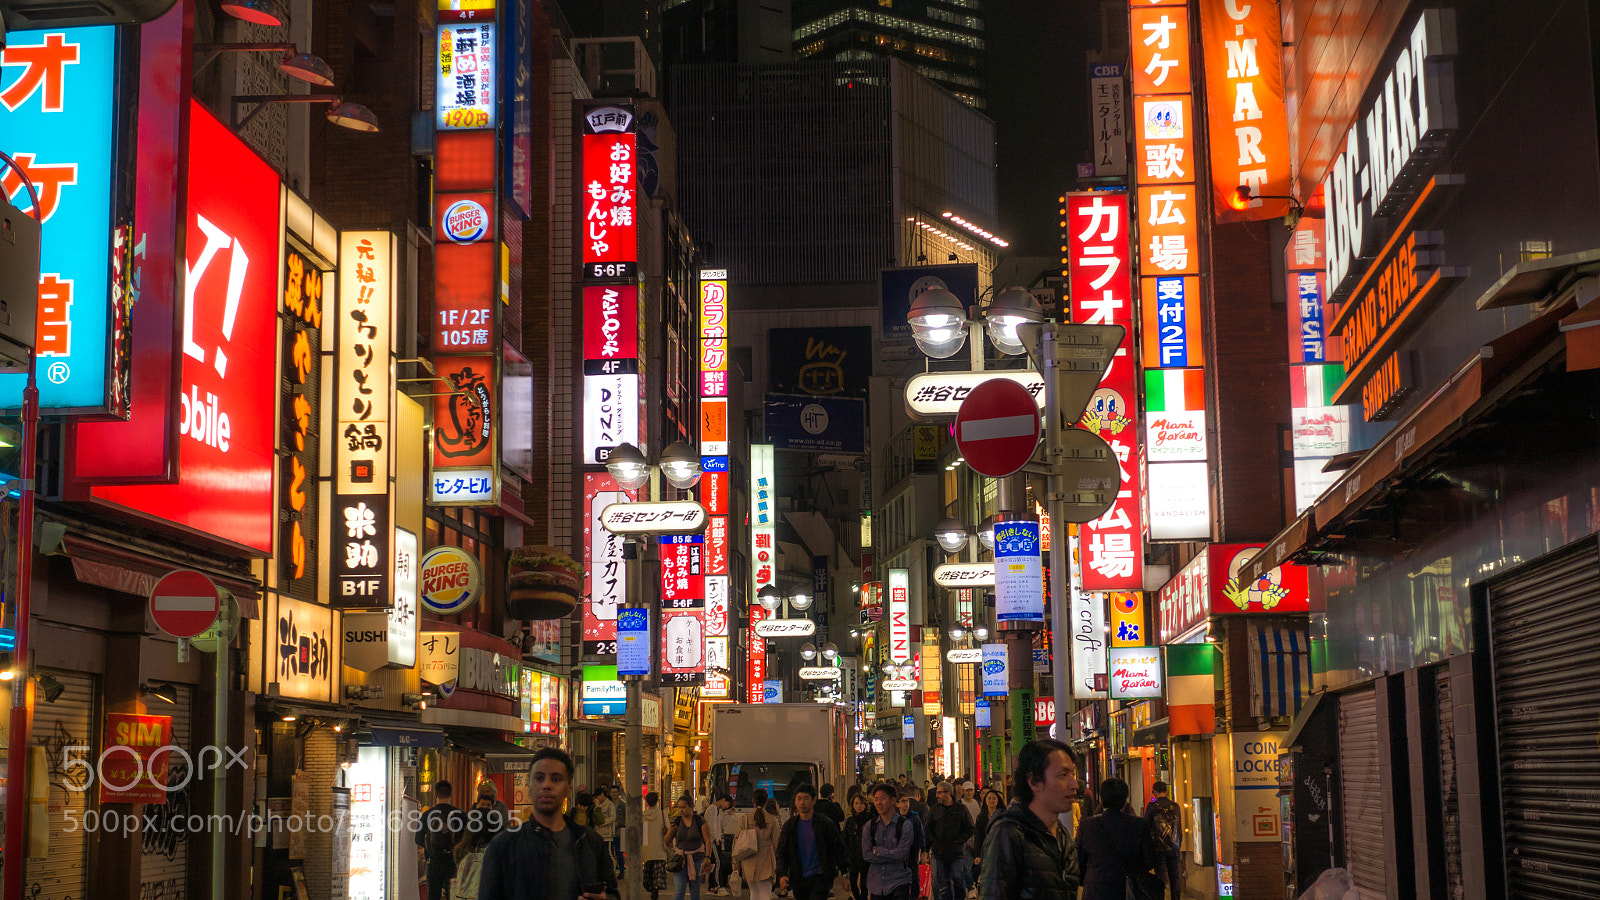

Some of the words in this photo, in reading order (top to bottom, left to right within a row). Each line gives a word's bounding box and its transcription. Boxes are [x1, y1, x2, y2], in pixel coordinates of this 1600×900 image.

[1094, 66, 1120, 76] CBR
[592, 113, 627, 127] 江戸前
[1099, 84, 1113, 166] モニタールーム
[1325, 9, 1430, 304] ABC-MART
[610, 142, 632, 227] お好み焼
[449, 209, 480, 225] BURGER
[1145, 144, 1189, 271] 歌広場
[450, 216, 482, 235] KING
[587, 180, 609, 256] もんじゃ
[1342, 288, 1377, 373] GRAND
[1378, 232, 1418, 327] STAGE
[703, 283, 725, 369] カラオケ
[1158, 280, 1184, 364] 受付2F
[441, 329, 489, 346] 105席
[601, 361, 620, 373] 4F
[704, 372, 724, 382] 受付
[1363, 350, 1400, 423] SHIBUYA
[704, 382, 725, 395] 3F
[180, 384, 231, 453] obile
[1150, 419, 1195, 430] Miami
[434, 477, 492, 495] センタービル
[709, 473, 719, 512] Exchange
[608, 509, 700, 523] 渋谷センター街
[343, 502, 379, 569] 米助
[672, 535, 692, 543] 85席
[712, 517, 725, 574] 野郎ラーメン
[422, 562, 469, 581] BURGER
[676, 544, 688, 590] お好み焼
[938, 569, 995, 581] 渋谷センター
[423, 572, 470, 596] KING
[663, 557, 675, 598] もんじゃ
[342, 580, 380, 596] B1F
[814, 567, 829, 648] 洋服の青
[345, 630, 387, 643] SUSHI
[1075, 610, 1102, 652] craft
[1116, 620, 1140, 641] 松
[422, 634, 457, 656] すし
[596, 642, 618, 655] 2·3
[674, 637, 684, 664] お食事
[1112, 668, 1149, 678] Miami
[586, 685, 626, 694] FamilyMart
[752, 683, 763, 691] 2F
[752, 694, 763, 702] 3F
[116, 721, 162, 747] SIM
[1243, 742, 1277, 755] COIN
[1235, 760, 1280, 773] LOCKE
